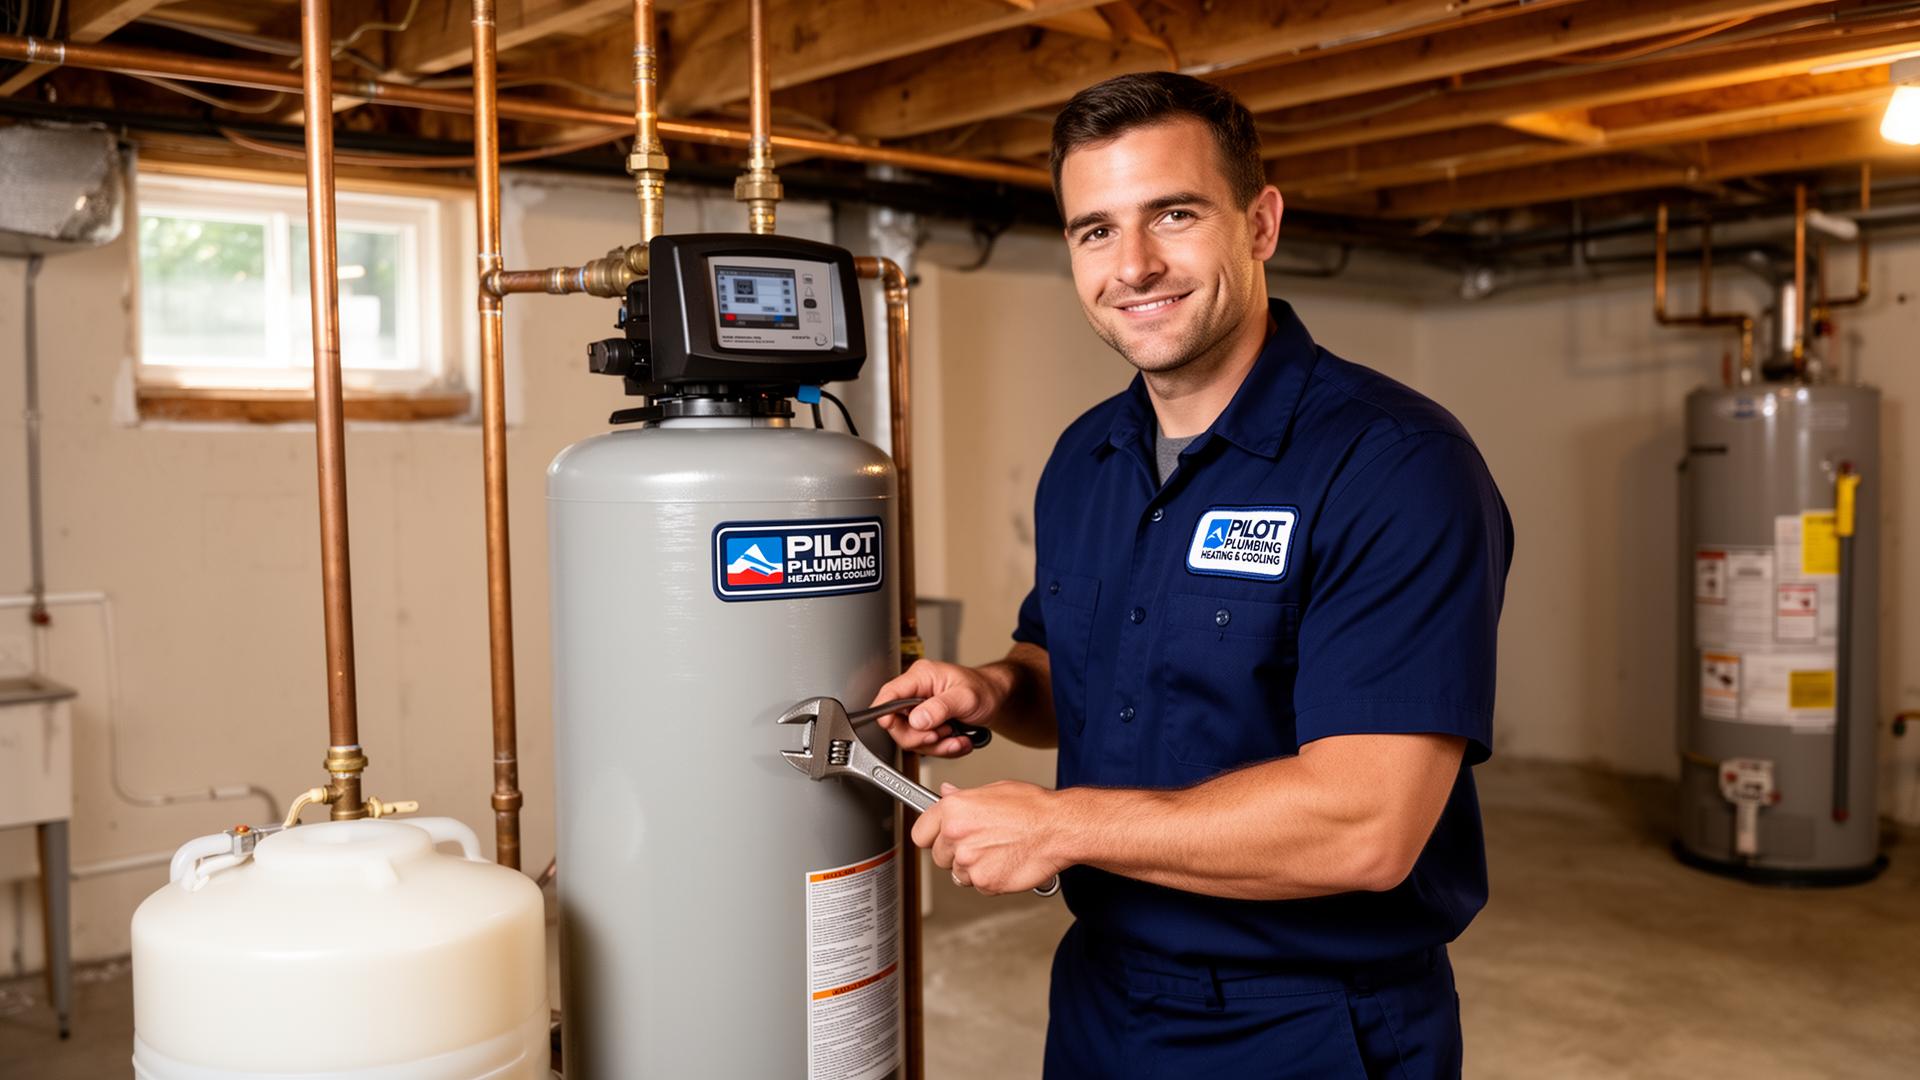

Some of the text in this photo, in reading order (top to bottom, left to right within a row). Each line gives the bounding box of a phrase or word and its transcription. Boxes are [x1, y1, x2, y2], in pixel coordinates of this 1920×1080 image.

[1228, 520, 1286, 540] PILOT
[787, 532, 875, 558] PILOT
[1224, 538, 1281, 554] PLUMBING
[787, 556, 875, 573] PLUMBING
[1201, 551, 1233, 560] HEATING
[1241, 552, 1280, 565] COOLING
[788, 573, 833, 583] HEATING
[843, 570, 876, 580] COOLING
